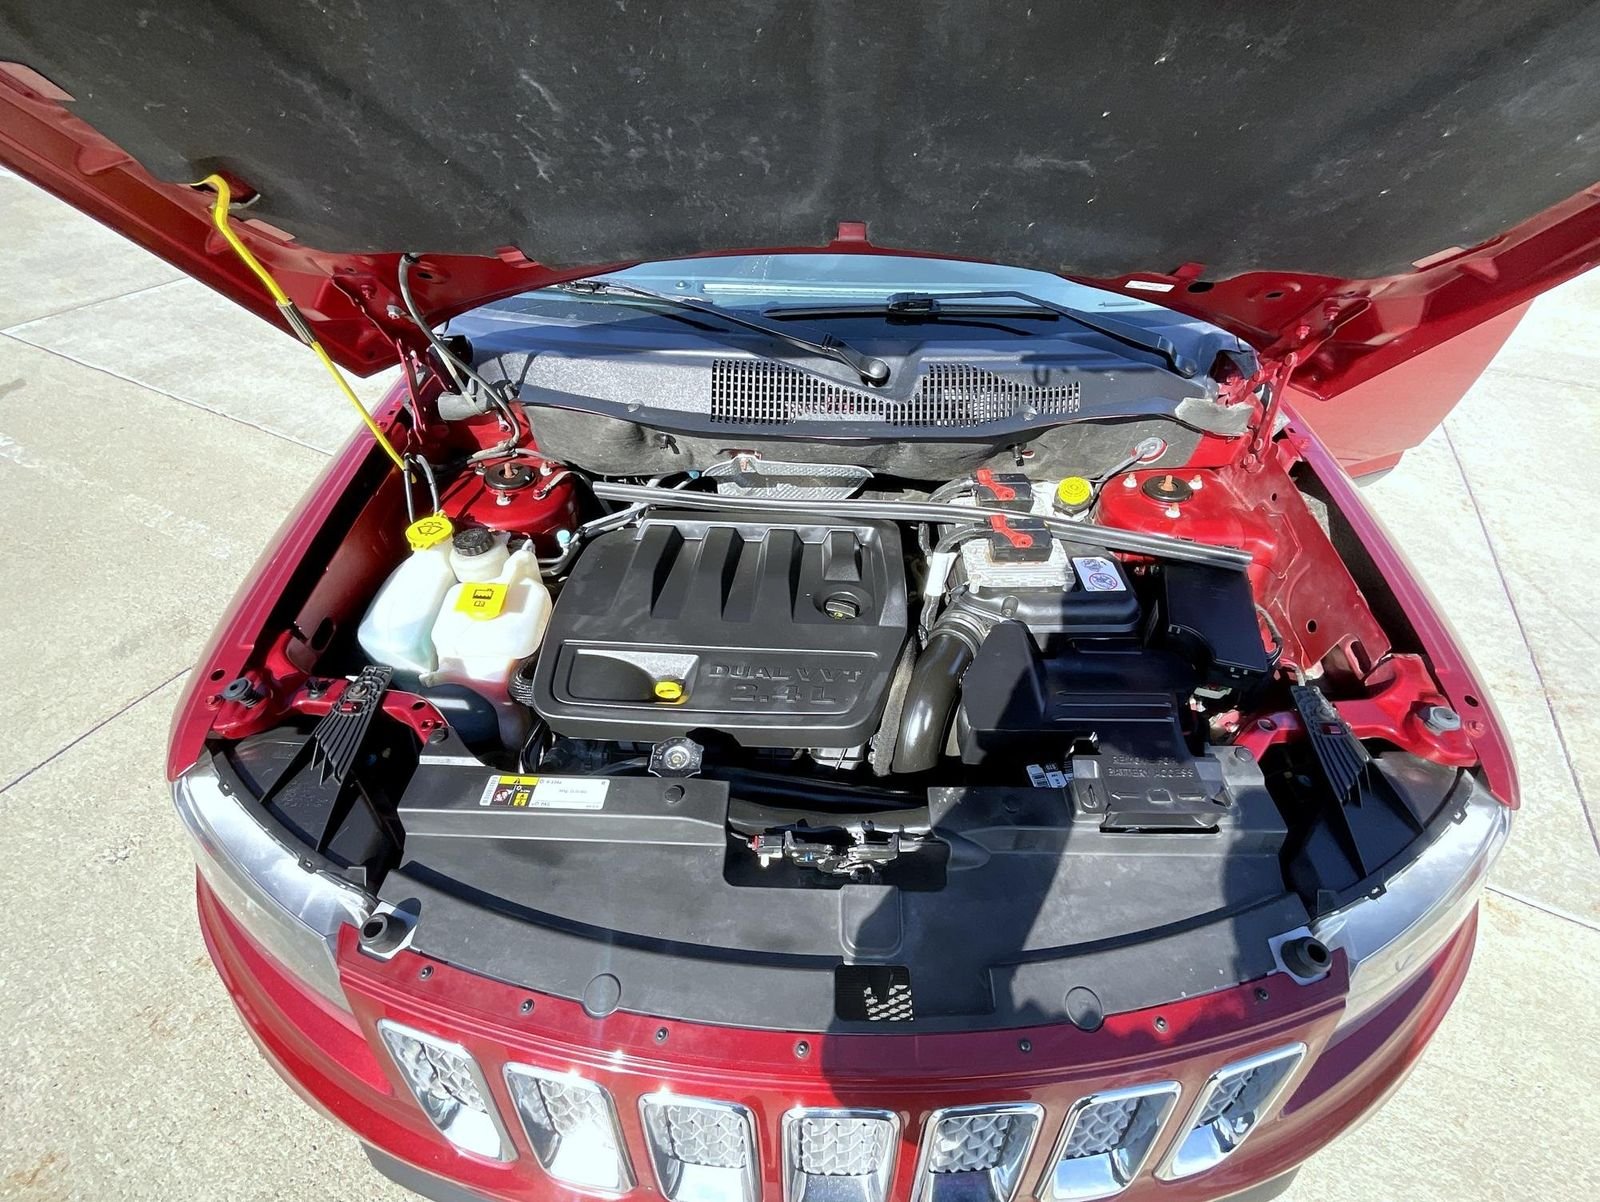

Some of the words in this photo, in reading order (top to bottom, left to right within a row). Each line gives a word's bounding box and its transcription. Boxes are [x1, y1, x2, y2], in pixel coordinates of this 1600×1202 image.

[708, 664, 790, 681] DUAL
[796, 667, 863, 682] VVT
[730, 684, 835, 704] 2.4L
[1107, 767, 1150, 778] BATTERY
[1153, 767, 1194, 778] ACCESS
